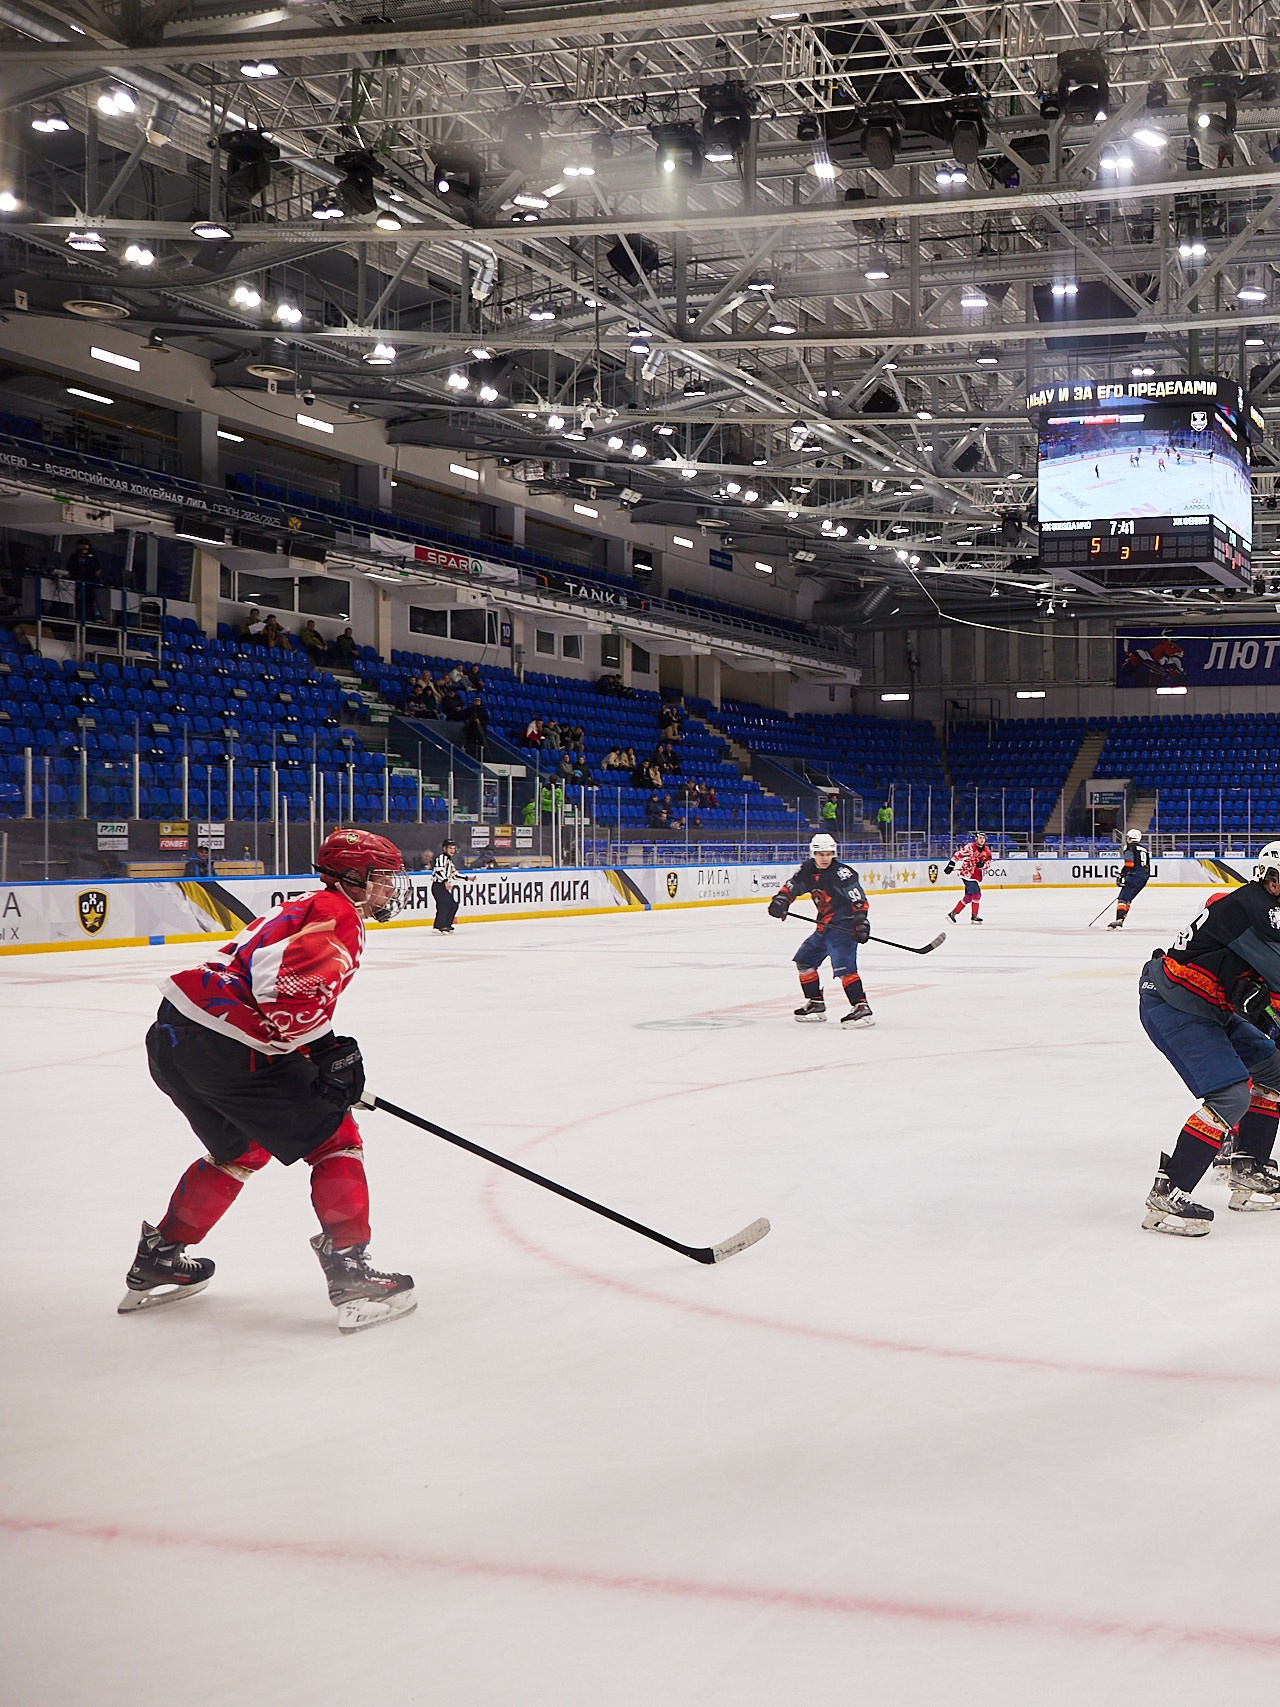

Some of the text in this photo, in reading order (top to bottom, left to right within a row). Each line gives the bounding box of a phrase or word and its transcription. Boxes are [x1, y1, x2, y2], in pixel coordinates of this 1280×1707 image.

[1058, 387, 1069, 401] И
[1073, 385, 1092, 400] ЗА
[1097, 384, 1124, 399] ЕГО
[1128, 380, 1217, 398] ПРЕДЕЛАМИ
[44, 463, 128, 491] ВСЕРОССИЙСКАЯ
[130, 483, 183, 504] ХОККЕЙНАЯ
[186, 498, 208, 510] ЛИГА
[212, 503, 240, 518] СЕЗОН
[240, 509, 281, 526] 2024/2025
[1110, 520, 1135, 535] 7:41
[1091, 535, 1160, 554] 5 1
[427, 551, 470, 571] SPAR
[1121, 547, 1130, 560] 3
[564, 582, 616, 605] TANK
[502, 625, 511, 638] 10
[160, 840, 188, 848] FONBET
[697, 870, 730, 886] ЛИГА
[451, 876, 544, 907] ОККЕЙНАЯ
[550, 880, 589, 901] ЛИГА
[848, 887, 861, 903] 93
